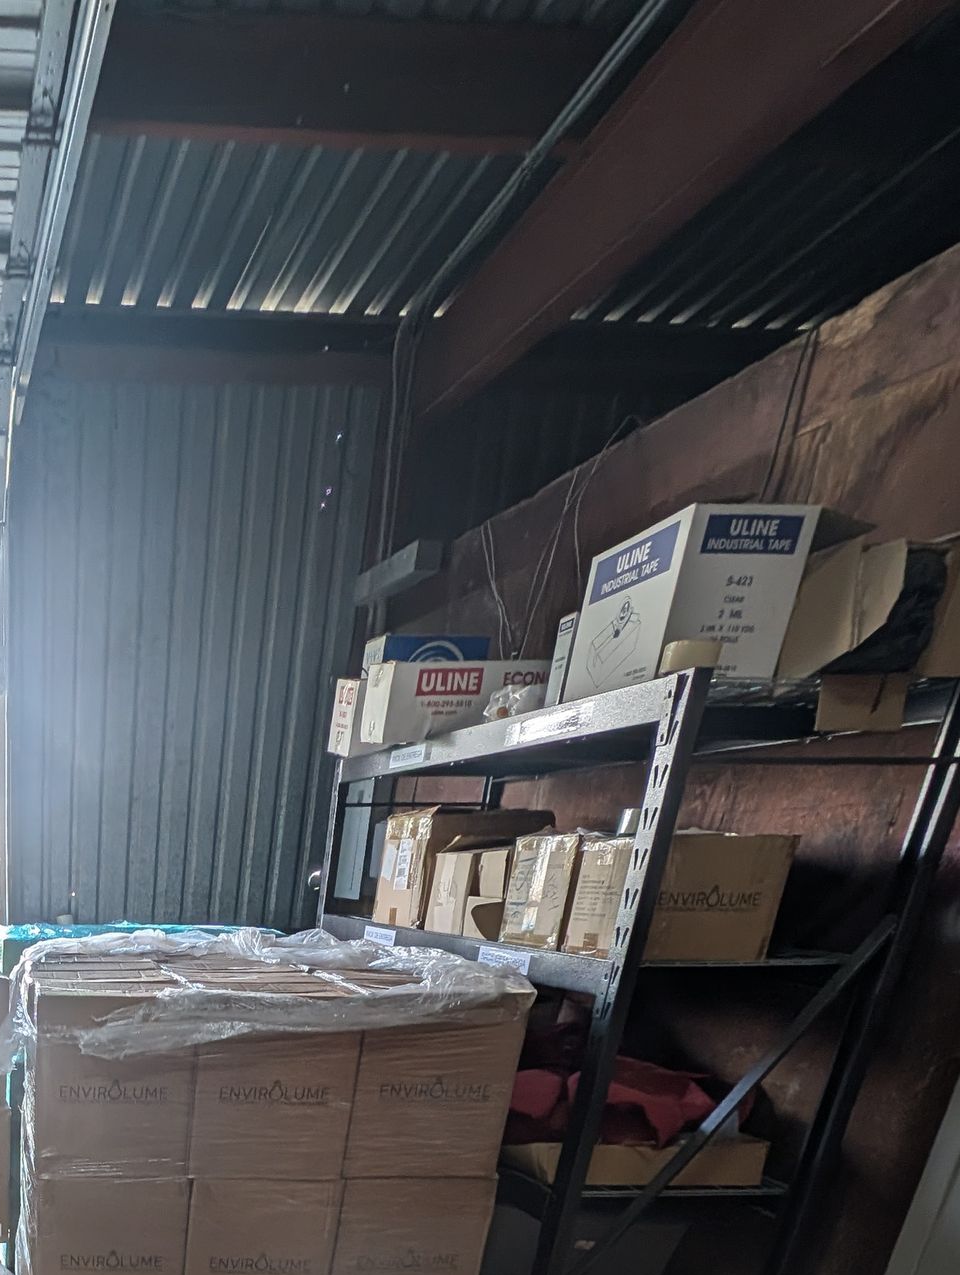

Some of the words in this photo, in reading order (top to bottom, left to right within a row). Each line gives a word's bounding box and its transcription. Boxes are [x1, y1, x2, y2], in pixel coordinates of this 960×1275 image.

[730, 519, 780, 537] ULINE
[707, 538, 764, 551] INDUSTRIAL
[768, 539, 793, 551] TAPE
[617, 541, 652, 574] ULINE
[601, 568, 639, 595] INDUSTRIAL
[641, 558, 660, 577] TAPE
[421, 672, 480, 692] ULINE
[503, 671, 551, 687] ECON
[658, 885, 763, 908] ENVIROLUME
[59, 1078, 168, 1100] ENVIROLUME
[219, 1079, 330, 1101] ENVIROLUME
[379, 1076, 491, 1099] ENVIROLUME
[60, 1249, 163, 1269] ENVIROLUME
[209, 1252, 311, 1272] ENVIROLUME
